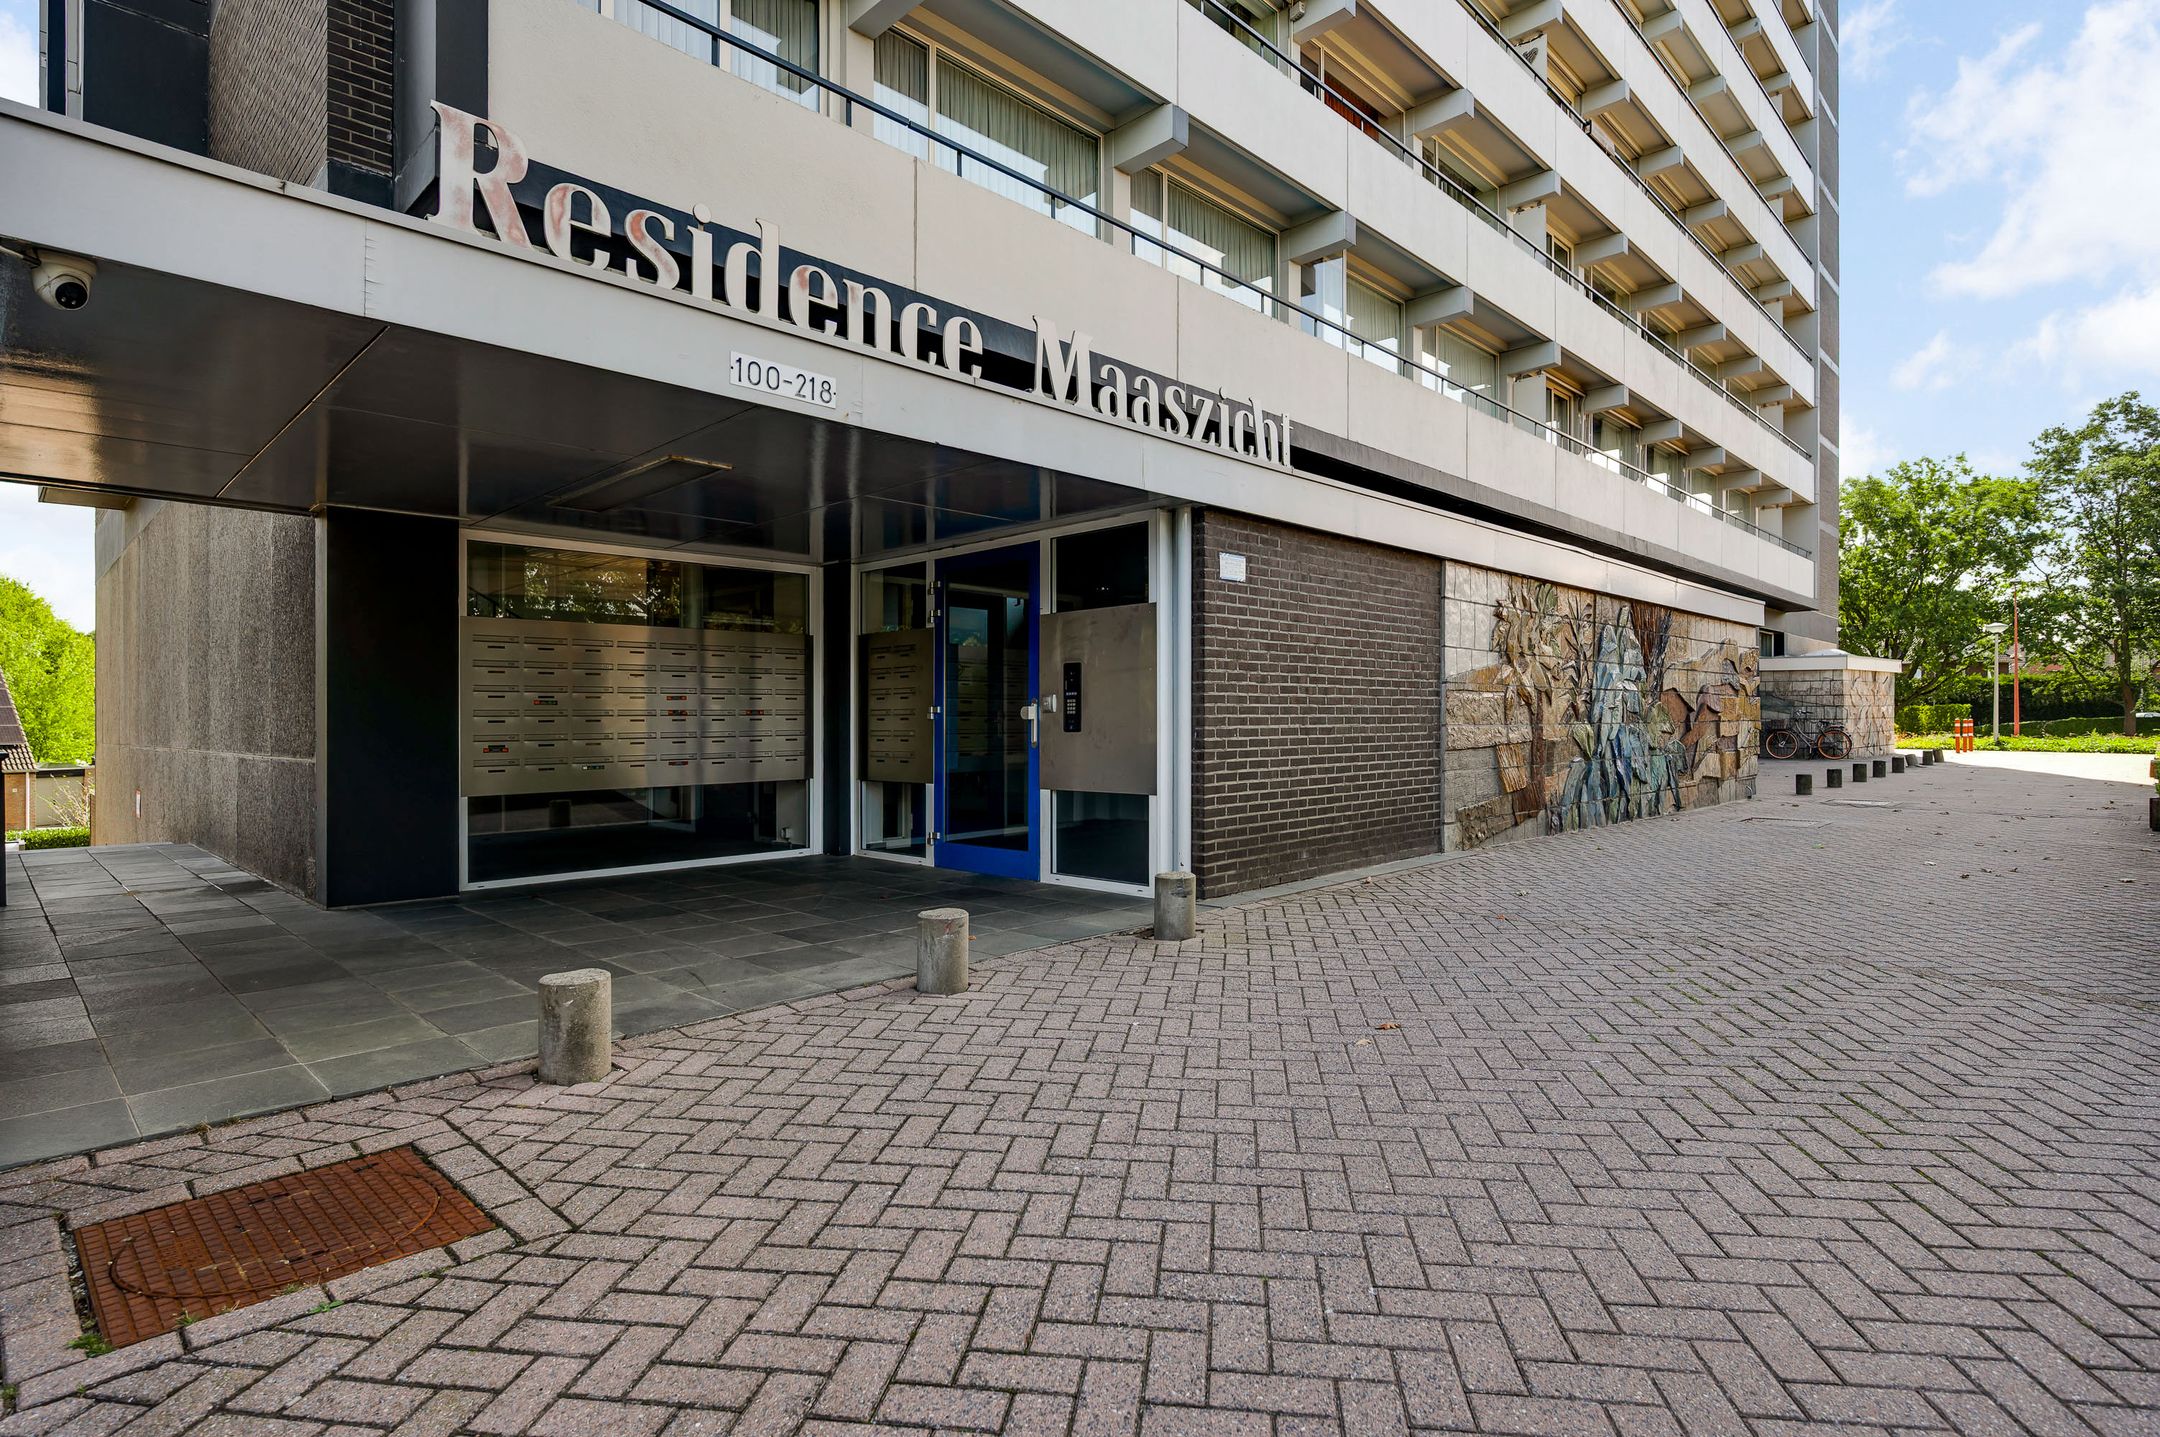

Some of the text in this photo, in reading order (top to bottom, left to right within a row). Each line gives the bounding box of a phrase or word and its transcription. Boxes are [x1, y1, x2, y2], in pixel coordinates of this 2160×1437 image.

[425, 99, 1294, 468] Residence Maaszicht
[736, 357, 832, 404] 100-218
